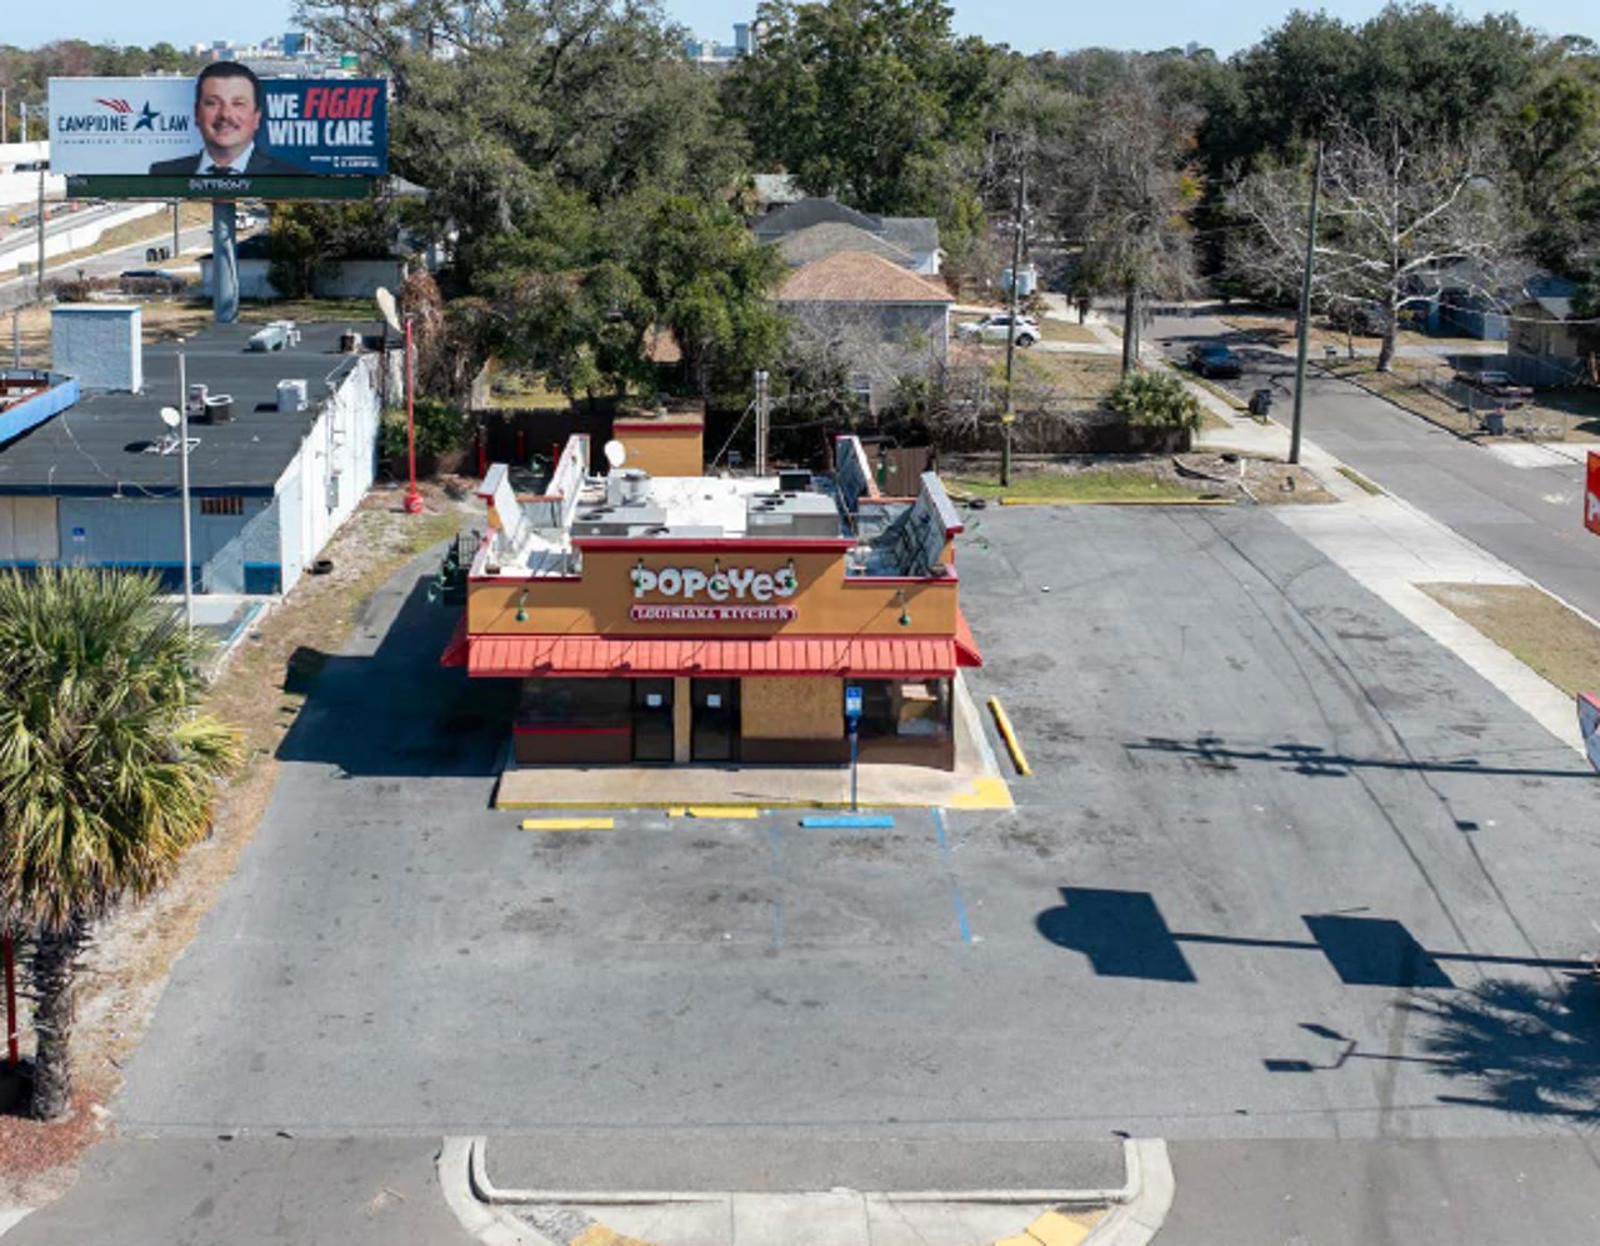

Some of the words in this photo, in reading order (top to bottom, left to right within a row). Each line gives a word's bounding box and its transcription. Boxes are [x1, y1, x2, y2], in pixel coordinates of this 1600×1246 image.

[266, 92, 299, 119] WE
[303, 86, 379, 119] FIGHT
[58, 115, 129, 132] CAMPIONE
[160, 115, 190, 132] LAW
[266, 120, 319, 147] WITH
[324, 120, 375, 147] CARE
[638, 606, 717, 620] LOUISIANA
[719, 606, 789, 620] KITCHEN
